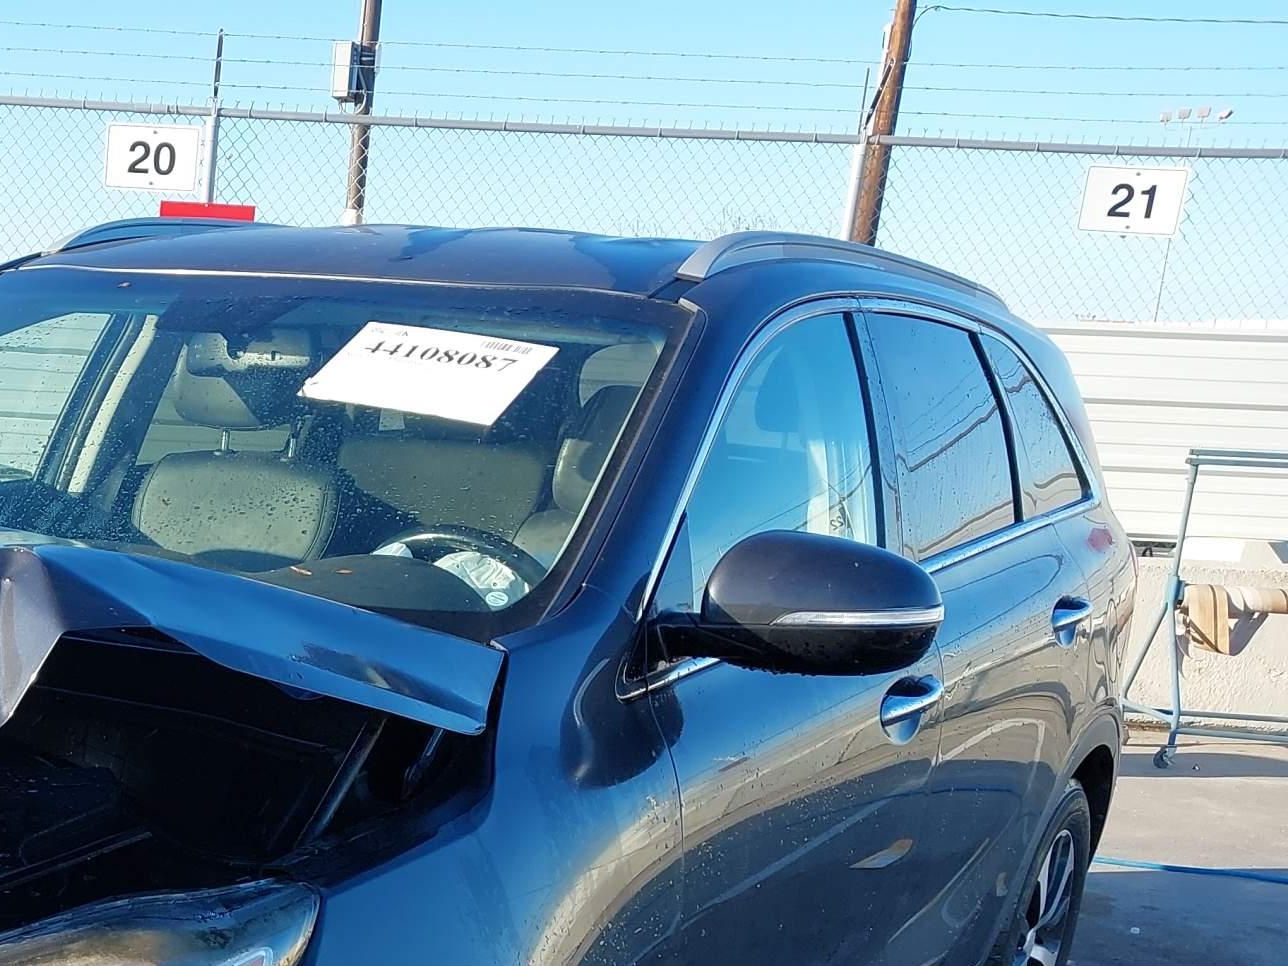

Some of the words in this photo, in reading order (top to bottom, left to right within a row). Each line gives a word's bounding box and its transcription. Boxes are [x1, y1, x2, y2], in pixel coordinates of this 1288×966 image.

[127, 140, 177, 176] 20
[1106, 183, 1158, 220] 21
[365, 340, 518, 372] 44108087
